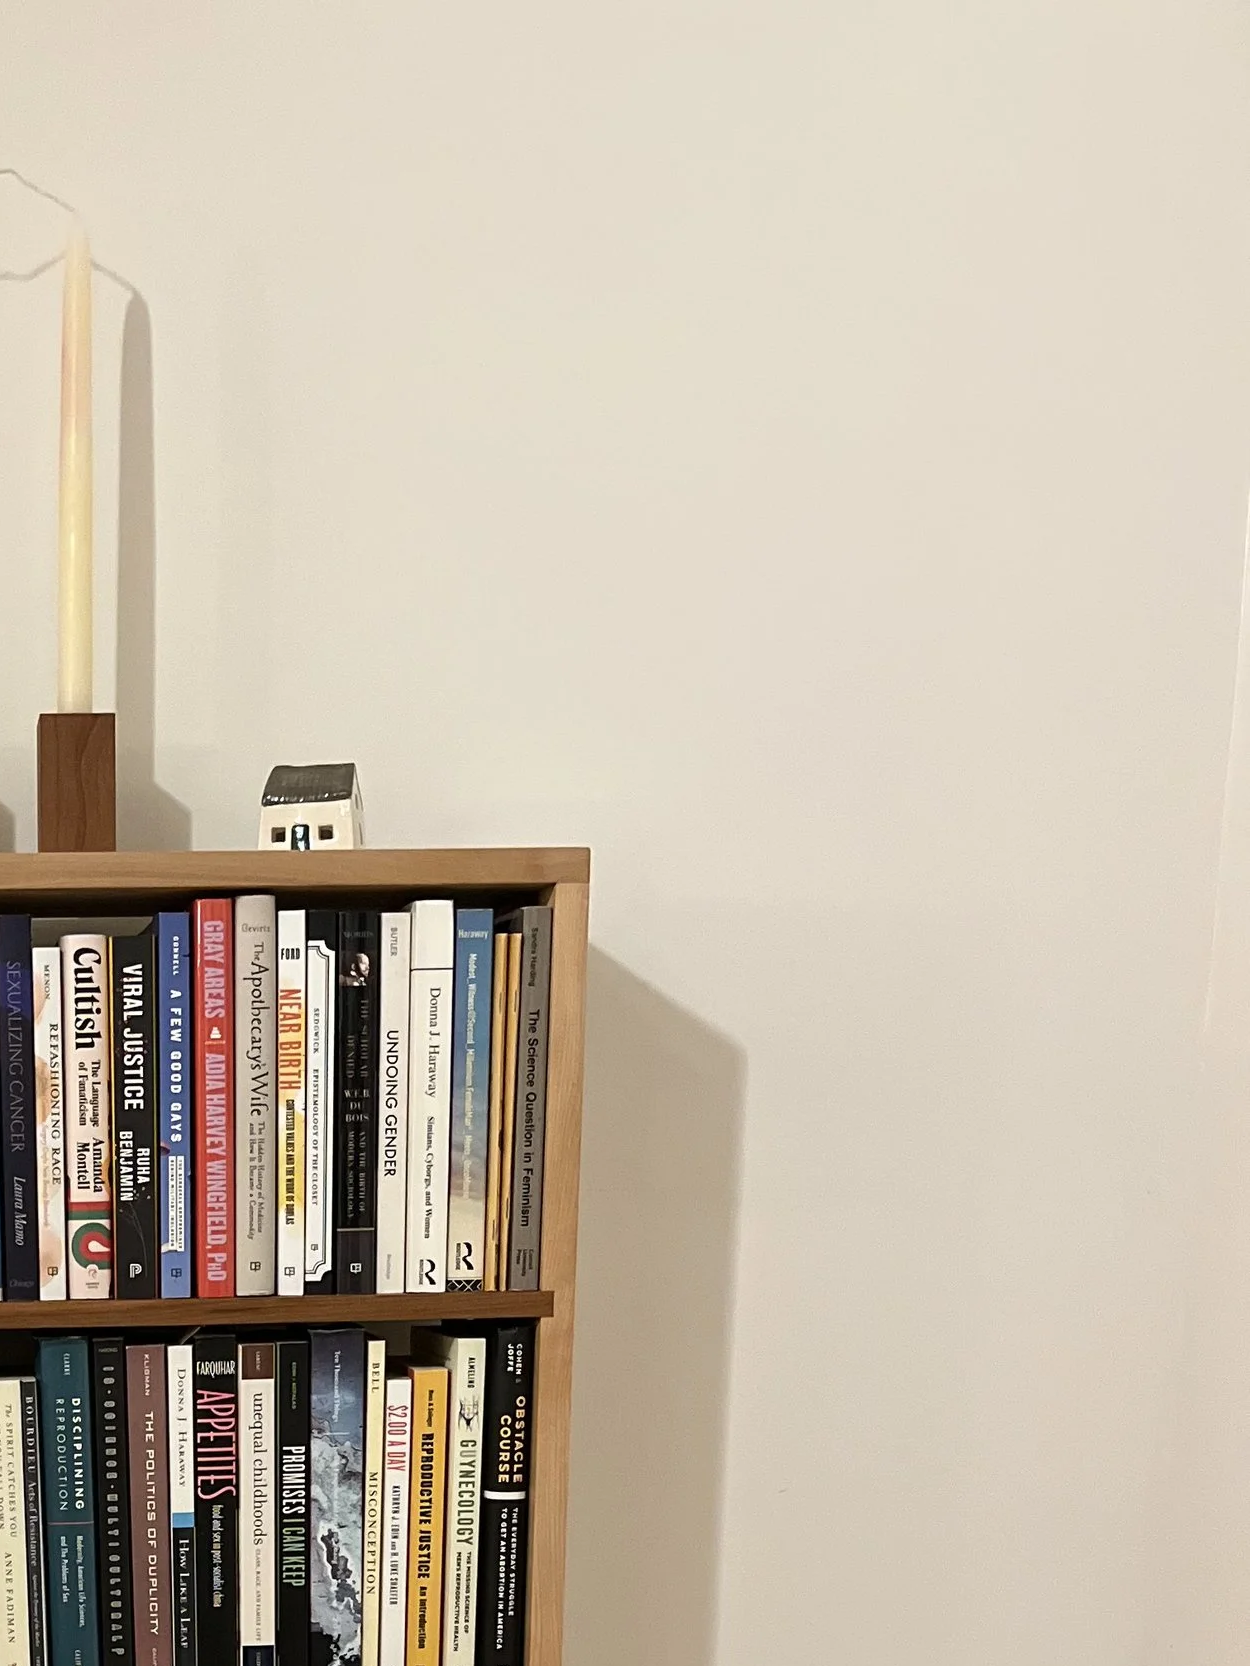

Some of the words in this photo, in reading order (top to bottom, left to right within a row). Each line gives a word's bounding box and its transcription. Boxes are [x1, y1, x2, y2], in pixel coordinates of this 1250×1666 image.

[204, 920, 223, 964] GRAY
[73, 947, 102, 1050] Cultish
[122, 964, 143, 1021] VIRAL
[204, 967, 225, 1018] AREAS
[528, 1009, 539, 1034] The
[123, 1028, 144, 1110] JUSTICE
[386, 1030, 398, 1109] UNDOING
[526, 1038, 538, 1087] Science
[384, 1115, 397, 1176] GENDER
[523, 1092, 536, 1147] Question
[76, 1142, 90, 1190] Montell
[91, 1137, 104, 1193] Amanda
[119, 1131, 134, 1201] BENJAMIN
[136, 1148, 150, 1184] RUHA
[524, 1152, 535, 1163] in
[13, 1176, 26, 1210] Laura
[521, 1168, 534, 1226] Feminism
[14, 1214, 25, 1245] Mamo
[371, 1363, 380, 1393] BELL
[197, 1390, 236, 1499] APPETITES
[248, 1393, 266, 1453] unequal
[498, 1415, 511, 1482] COURSE
[513, 1396, 526, 1483] OBSTACLE
[253, 1459, 268, 1545] childhoods
[282, 1446, 305, 1514] PROMISES
[456, 1439, 477, 1545] GUYNECOLOGY
[283, 1527, 305, 1551] CAN
[366, 1472, 378, 1595] MISCONCEPTION
[283, 1555, 305, 1586] KEEP
